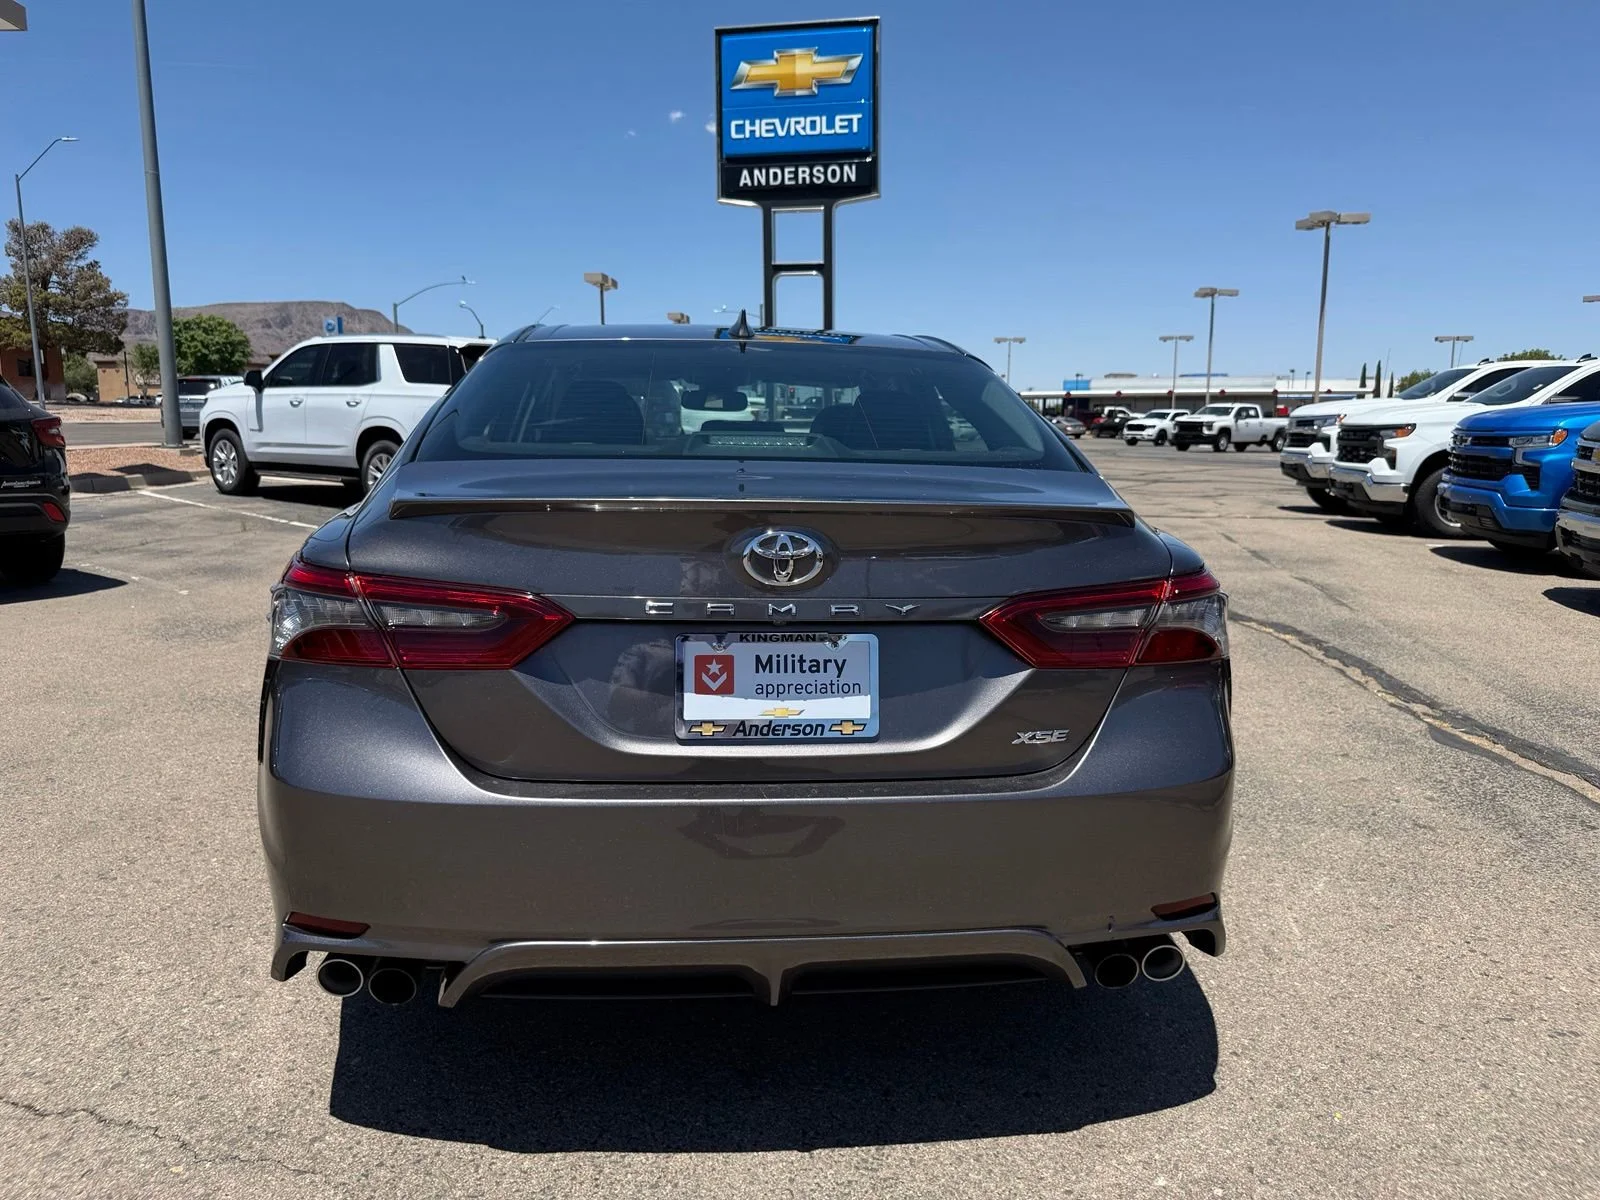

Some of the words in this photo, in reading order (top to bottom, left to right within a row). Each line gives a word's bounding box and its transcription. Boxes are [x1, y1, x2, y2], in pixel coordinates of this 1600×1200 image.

[730, 114, 863, 139] CHEVROLET
[739, 164, 857, 187] ANDERSON
[645, 600, 921, 616] CAMRY
[739, 633, 816, 643] KINGMAN
[754, 654, 847, 678] Military
[754, 679, 861, 698] appreciation
[732, 720, 825, 737] Anderson
[1011, 729, 1070, 745] XSE
